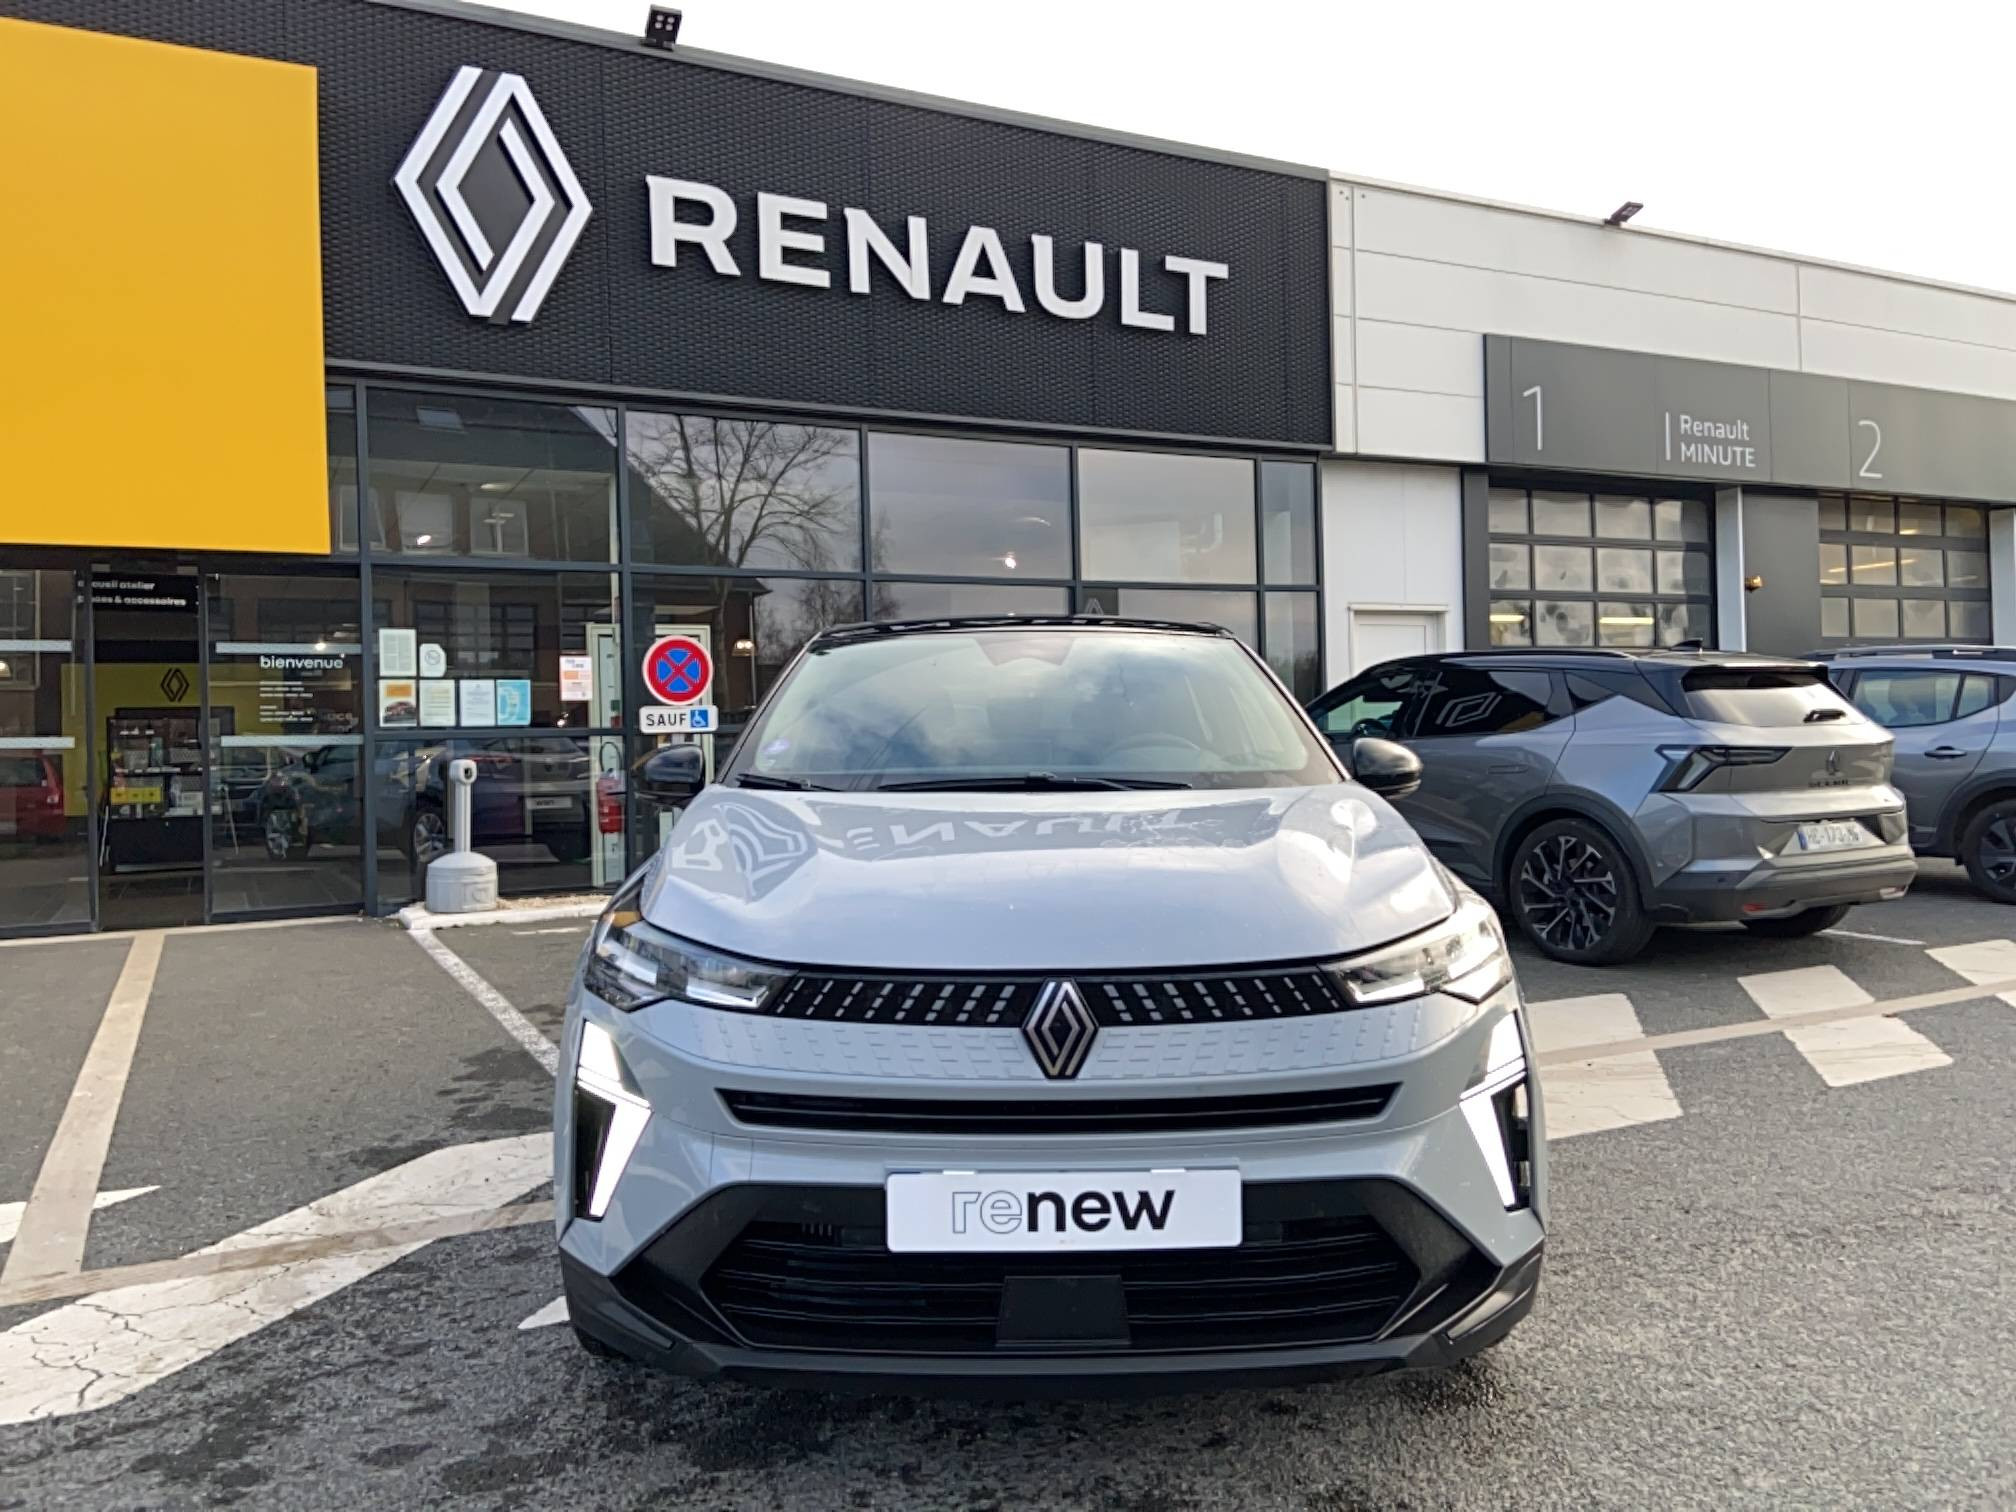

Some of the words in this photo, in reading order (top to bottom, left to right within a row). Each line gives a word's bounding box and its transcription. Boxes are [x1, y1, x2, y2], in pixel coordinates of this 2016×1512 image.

[645, 175, 1229, 335] RENAULT
[1522, 385, 1543, 451] 1
[1679, 414, 1750, 441] Renault
[1680, 442, 1756, 467] MINUTE
[1857, 420, 1883, 479] 2
[260, 655, 344, 669] bienvenue
[646, 713, 687, 727] SAUF
[951, 1189, 1175, 1234] renew
